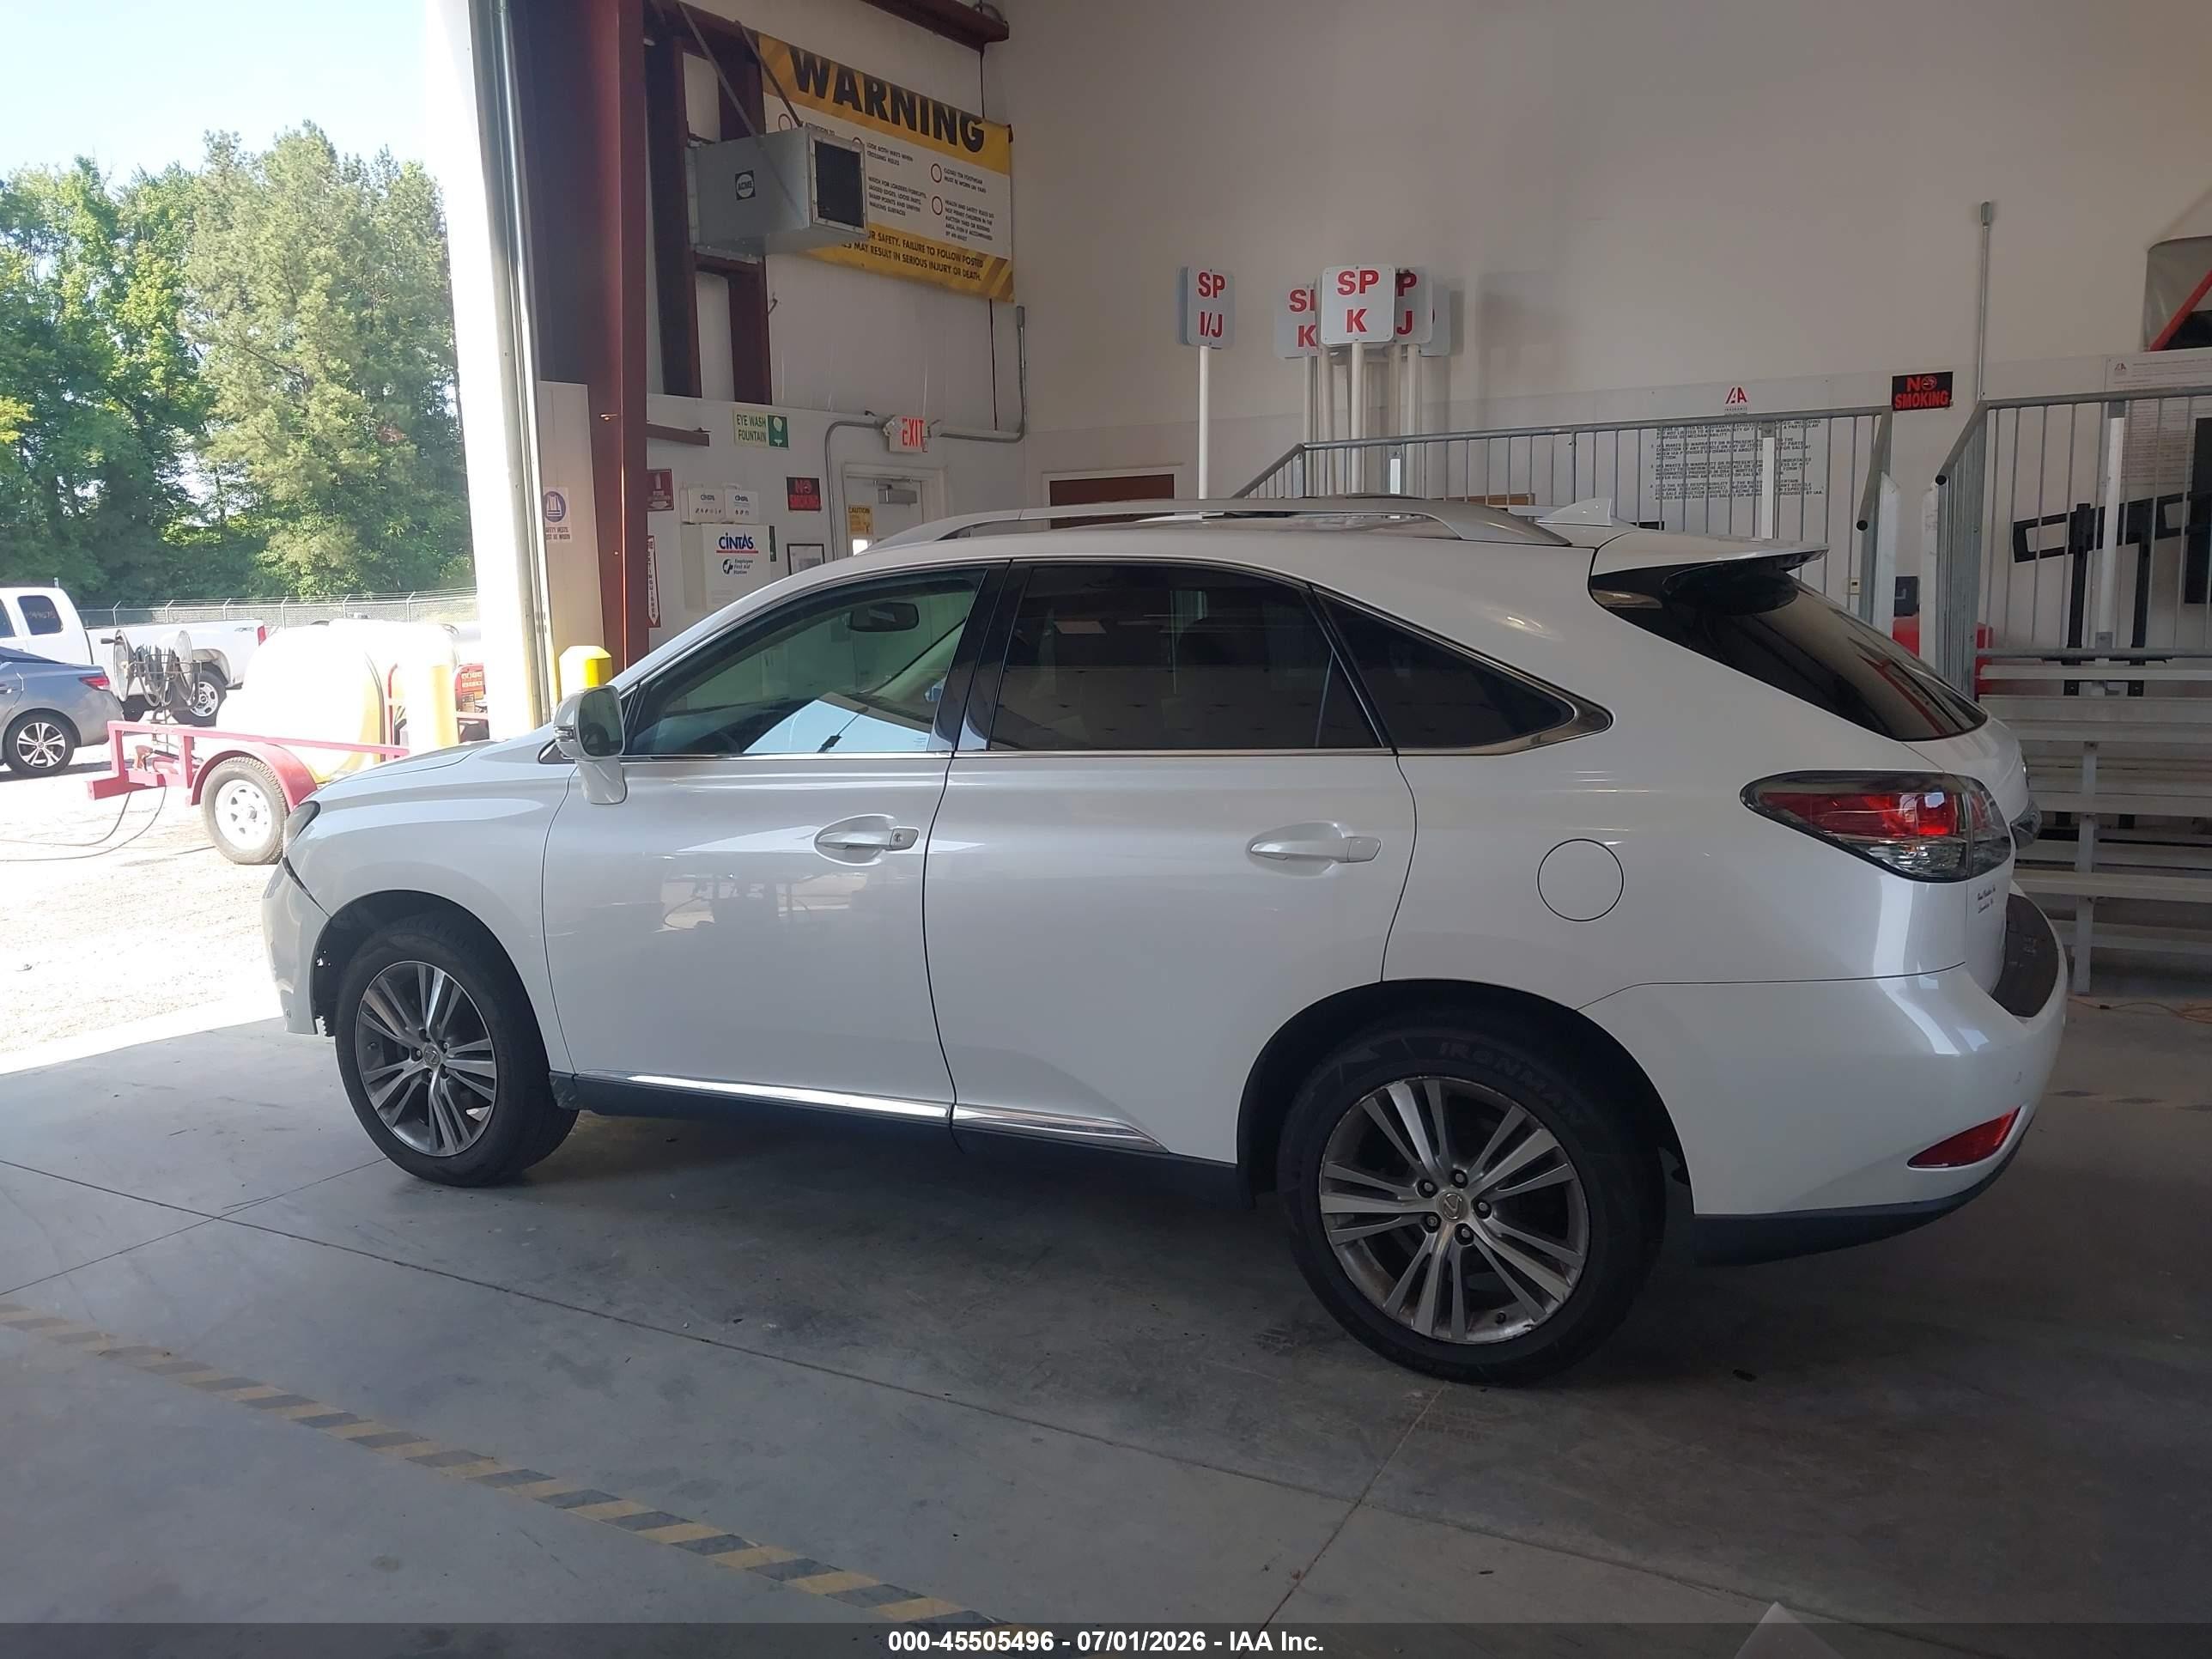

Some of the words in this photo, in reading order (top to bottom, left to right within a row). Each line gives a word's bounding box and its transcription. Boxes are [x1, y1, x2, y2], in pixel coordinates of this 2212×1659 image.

[790, 46, 985, 153] WARNING
[854, 241, 868, 252] MAY
[870, 246, 892, 259] RESULT
[893, 251, 901, 261] IN
[902, 253, 927, 269] SERIOUS
[928, 261, 951, 275] INJURY
[953, 267, 962, 276] OR
[902, 240, 926, 254] FAILURE
[927, 246, 935, 256] TO
[937, 248, 962, 262] FOLLOW
[962, 255, 984, 269] POSTED
[1198, 271, 1225, 299] SP
[1337, 269, 1380, 296] SP
[1395, 272, 1418, 297] P
[1200, 311, 1224, 338] I/J
[1346, 307, 1368, 333] K
[1396, 310, 1413, 336] J
[1297, 325, 1316, 348] K
[1906, 375, 1937, 392] NO
[1894, 390, 1949, 410] SMOKING
[736, 414, 748, 426] EYE
[749, 415, 767, 428] WASH
[902, 417, 924, 447] EXIT
[738, 429, 767, 443] FOUNTAIN
[794, 479, 812, 495] NO
